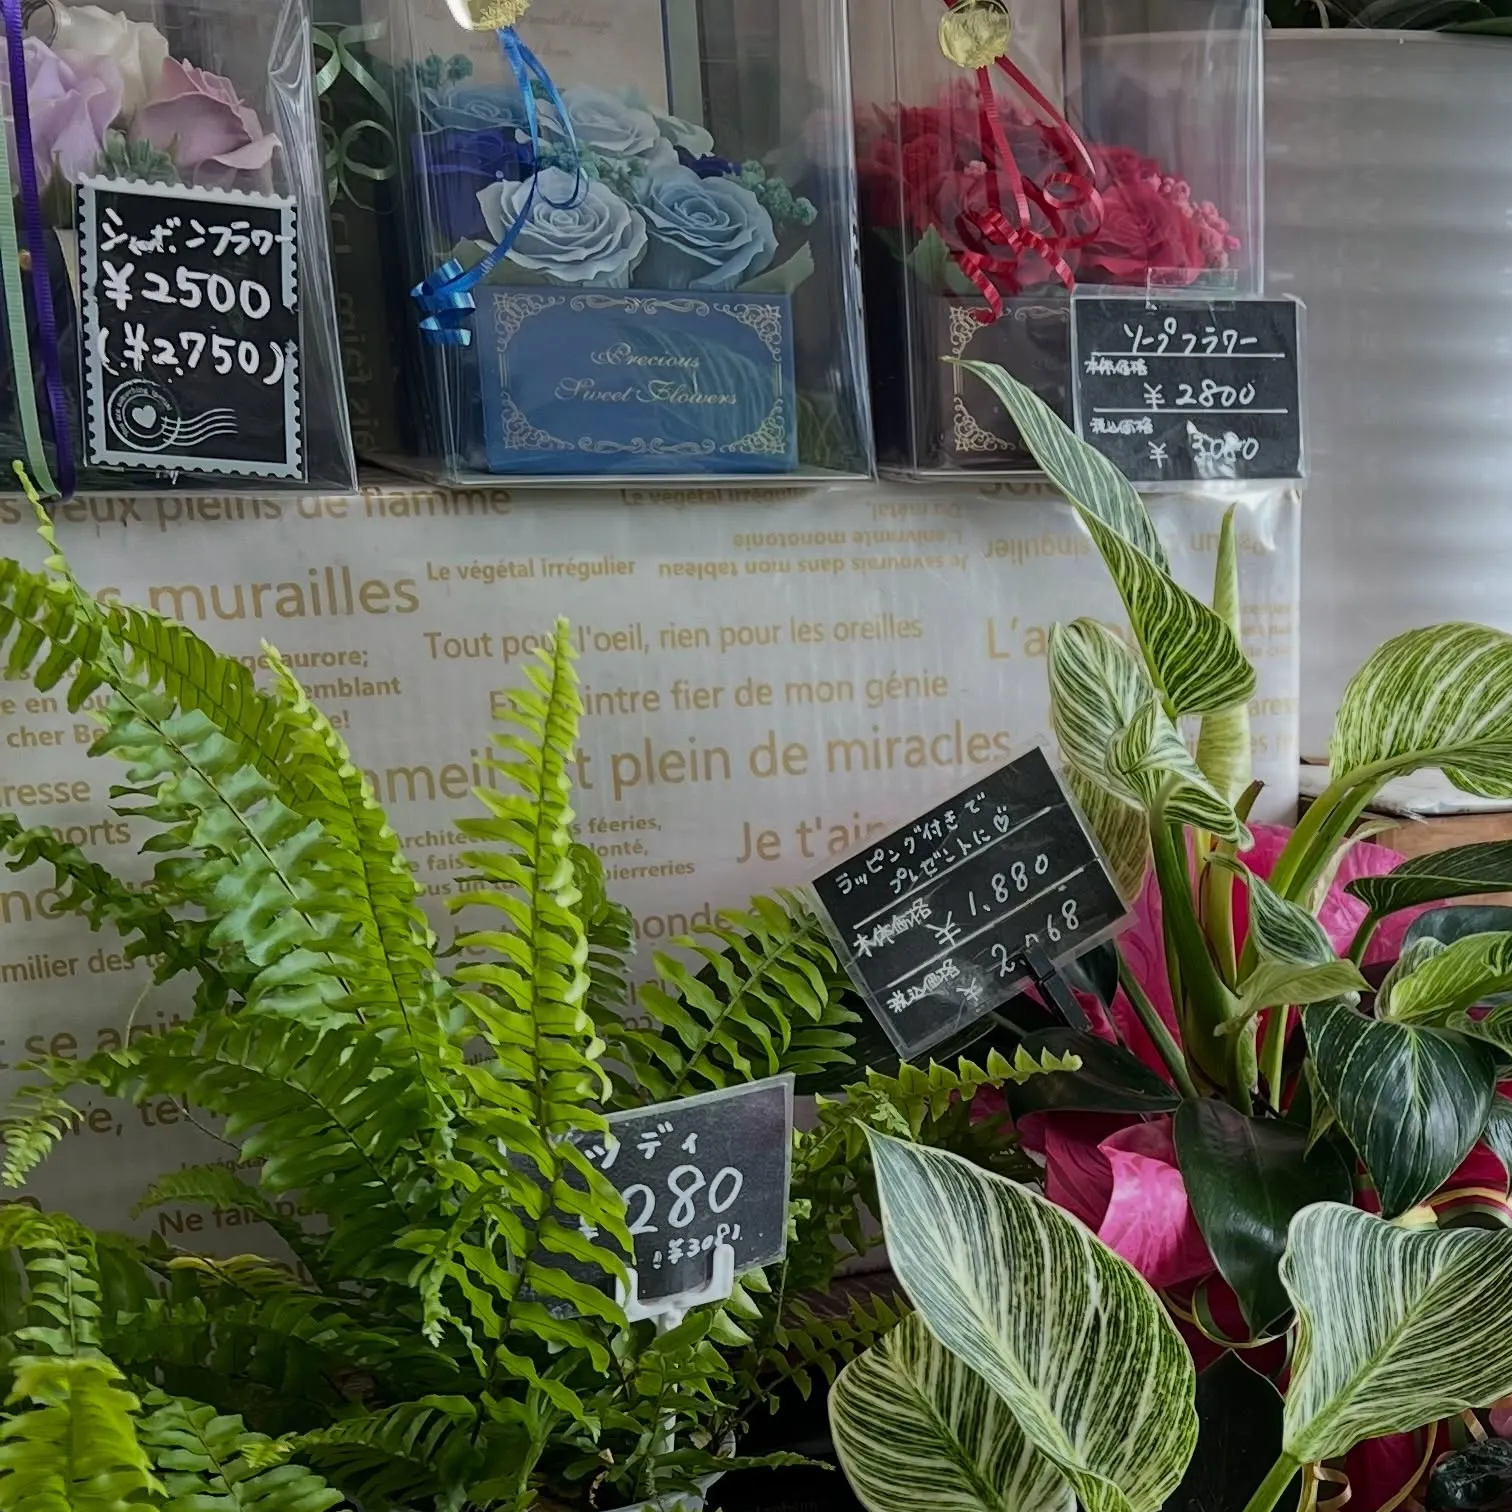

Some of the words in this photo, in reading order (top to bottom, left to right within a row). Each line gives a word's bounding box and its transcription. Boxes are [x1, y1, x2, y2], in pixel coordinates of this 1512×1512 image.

[102, 260, 271, 319] ¥2500
[1122, 316, 1258, 356] ソープフラワー
[591, 342, 701, 368] Precious
[554, 377, 631, 402] Sweet
[635, 379, 737, 405] Flowers
[427, 562, 451, 582] Le
[457, 559, 534, 582] végétal
[541, 557, 636, 581] irrégulier
[658, 561, 738, 580] tableau
[745, 561, 790, 577] mon
[798, 558, 844, 577] dans
[148, 566, 419, 620] murailles
[423, 632, 492, 660] Tout
[658, 622, 713, 650] rien
[719, 622, 780, 653] pour
[790, 617, 824, 643] les
[832, 616, 922, 643] oreilles
[302, 677, 401, 699] emblant
[669, 682, 723, 711] fier
[735, 679, 772, 708] de
[785, 678, 854, 703] mon
[866, 671, 949, 709] génie
[612, 738, 730, 801] plein
[748, 733, 807, 778] de
[826, 720, 1012, 772] miracles
[736, 822, 780, 866] Je
[159, 1209, 204, 1236] Ne
